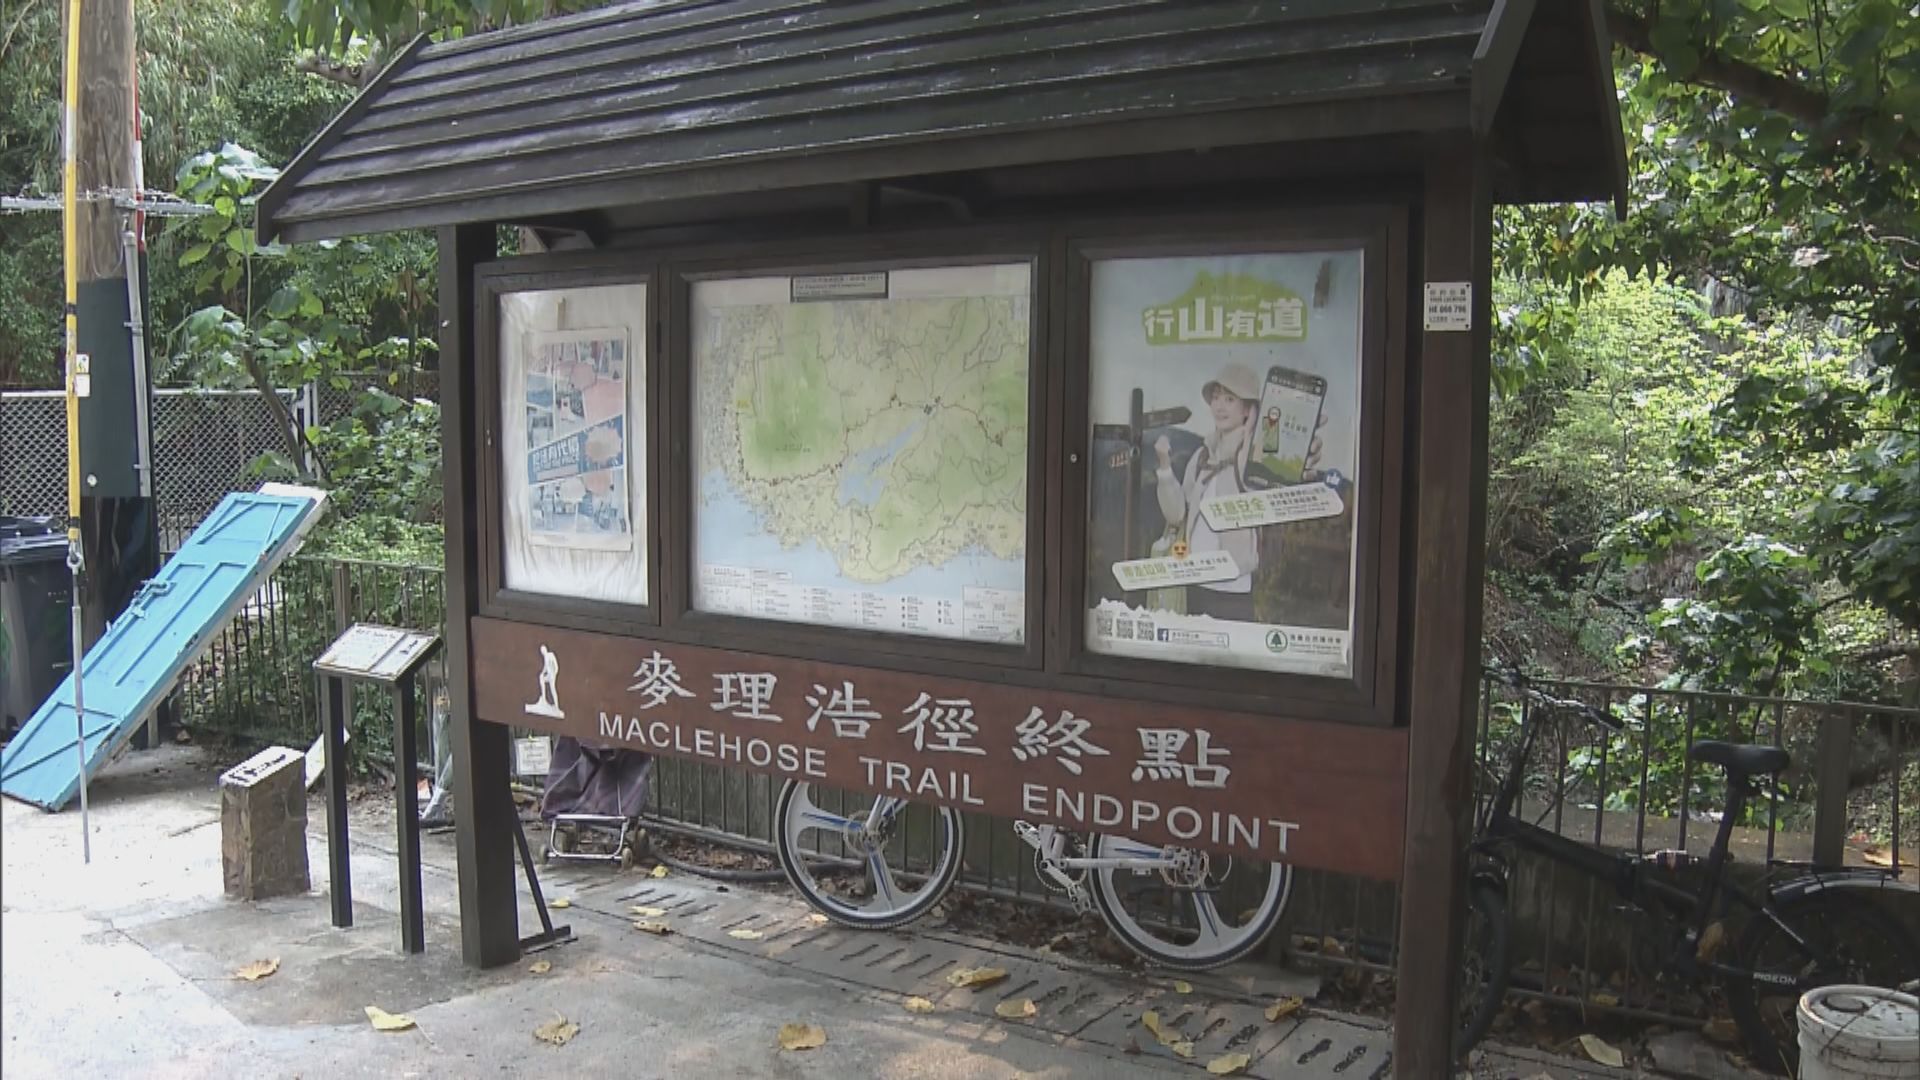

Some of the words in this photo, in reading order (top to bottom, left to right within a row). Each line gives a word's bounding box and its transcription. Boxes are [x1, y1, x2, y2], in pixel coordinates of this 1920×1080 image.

[1145, 298, 1303, 341] 行山有道
[1209, 497, 1265, 519] 注意安全
[626, 650, 1231, 788] 麥理浩徑終點
[599, 711, 827, 778] MACLEHOSE
[858, 756, 984, 809] TRAIL
[1022, 782, 1300, 854] ENDPOINT
